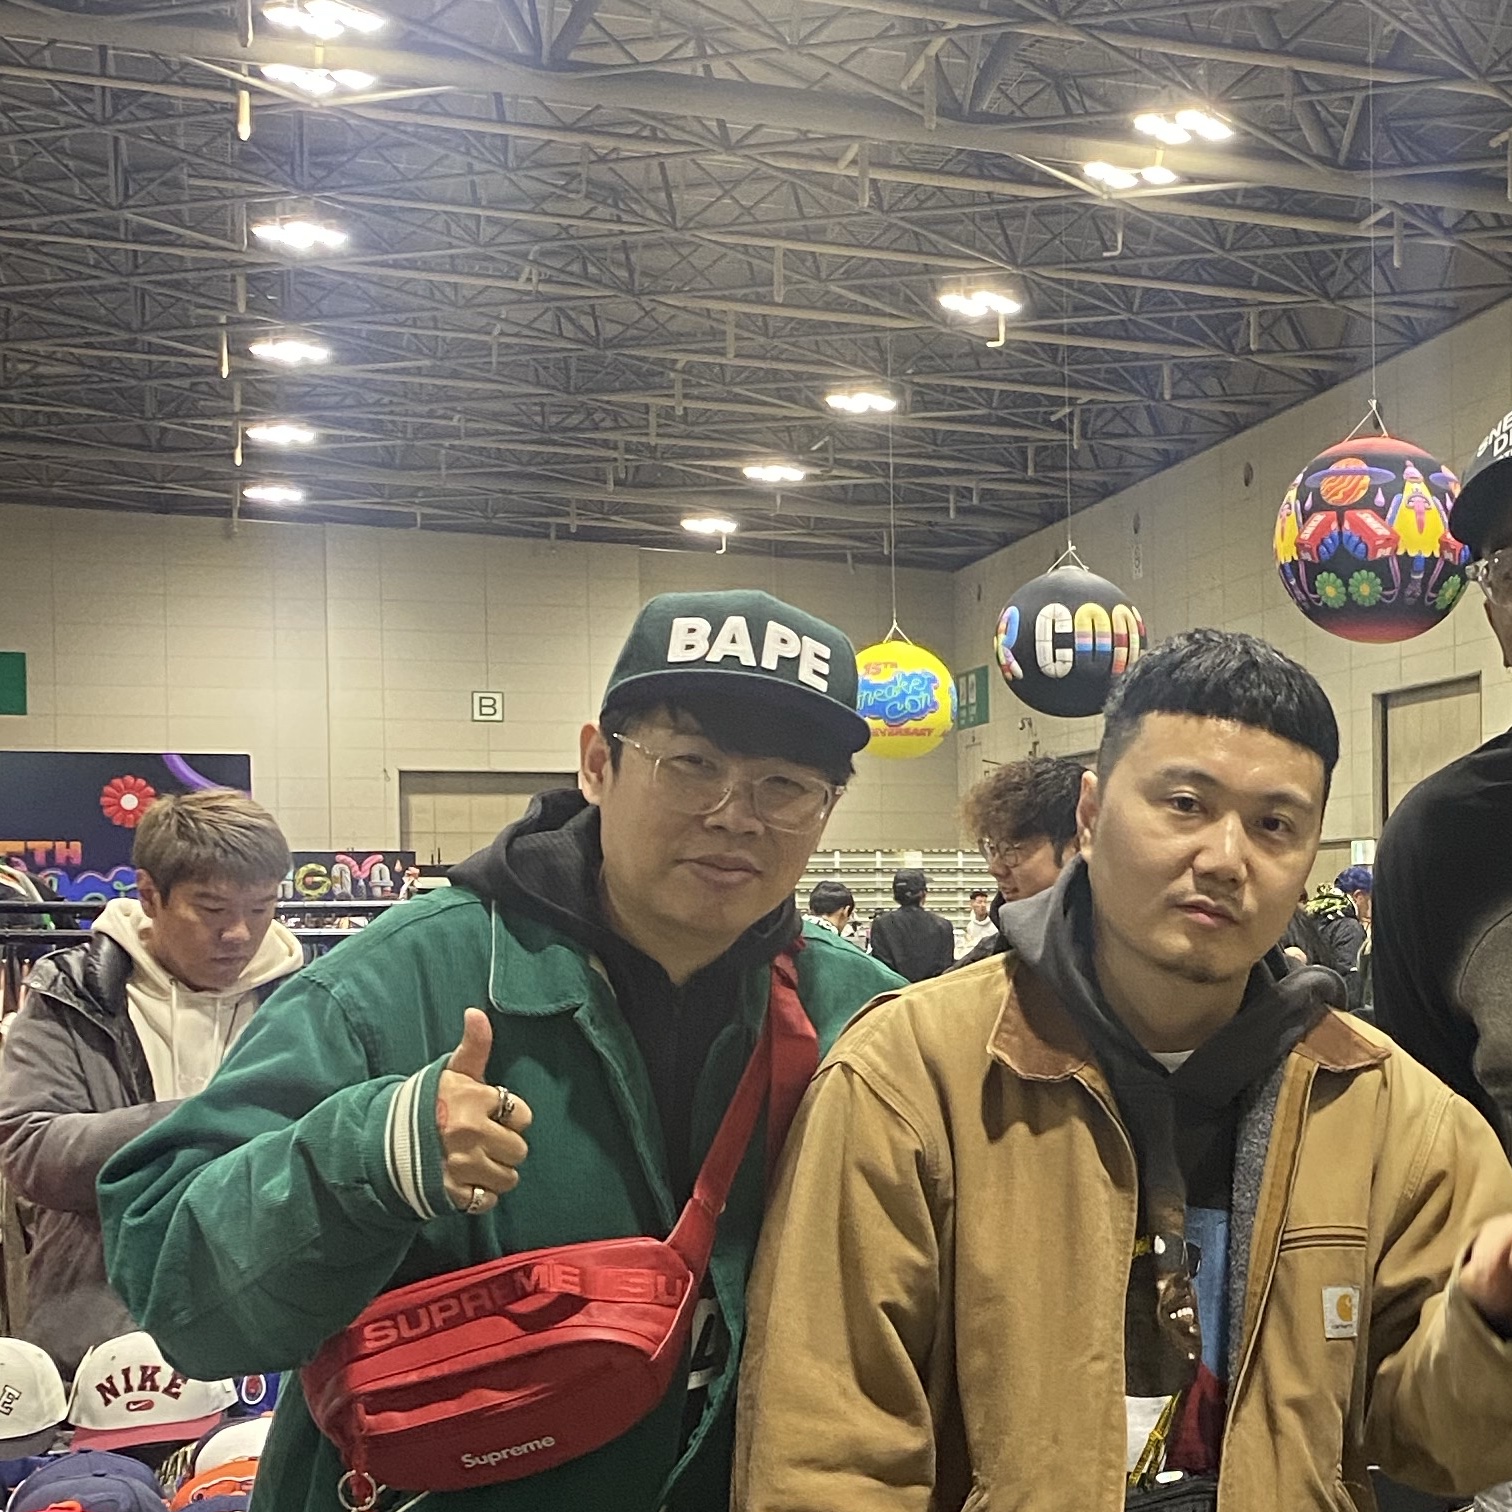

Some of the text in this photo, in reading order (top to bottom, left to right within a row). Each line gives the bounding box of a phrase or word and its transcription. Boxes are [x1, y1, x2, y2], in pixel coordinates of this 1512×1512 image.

[667, 615, 832, 693] BAPE
[479, 696, 497, 716] B
[95, 1364, 187, 1407] NIKE
[461, 1436, 556, 1468] Supreme
